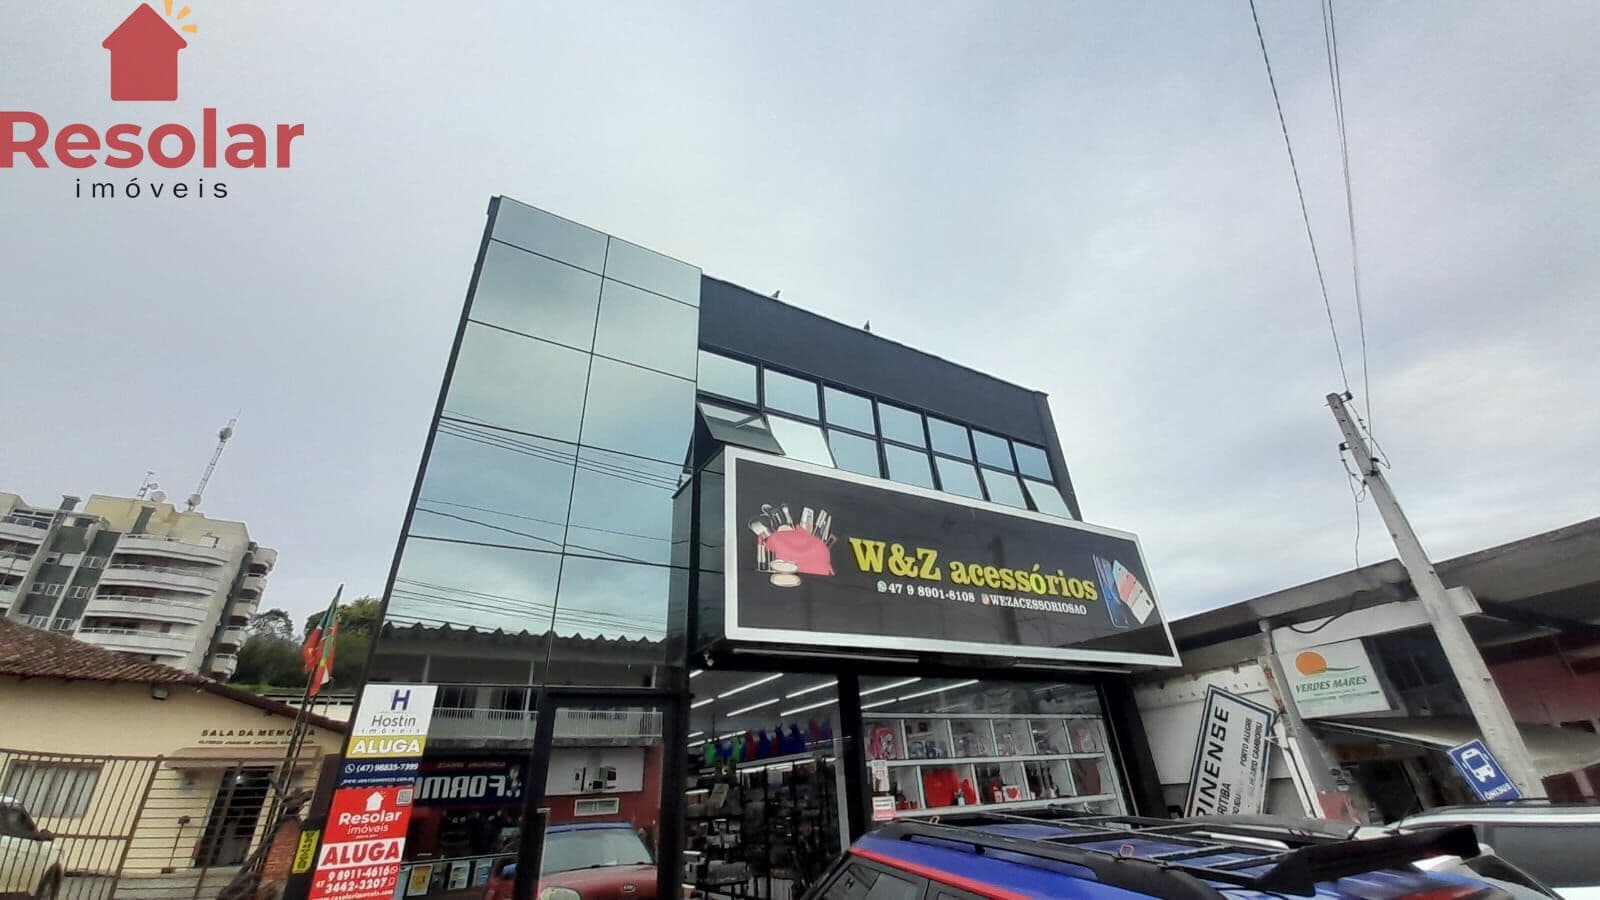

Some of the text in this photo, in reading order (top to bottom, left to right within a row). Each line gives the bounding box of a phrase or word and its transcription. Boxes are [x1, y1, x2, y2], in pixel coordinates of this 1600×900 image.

[849, 537, 1098, 601] W&Z acessórios
[888, 582, 903, 594] 47
[907, 584, 915, 595] 9
[917, 586, 976, 603] 8901-8108
[1296, 680, 1331, 693] VERDES
[1332, 675, 1368, 688] MARES
[390, 689, 411, 711] H
[371, 714, 417, 728] Hostin
[201, 729, 235, 737] SALA
[238, 729, 255, 737] DA
[351, 738, 421, 755] ALUGA
[338, 810, 403, 826] Resolar
[347, 824, 390, 836] imóveis
[320, 841, 401, 867] ALUGA
[328, 871, 336, 882] 9
[325, 876, 388, 895] 3442-3207
